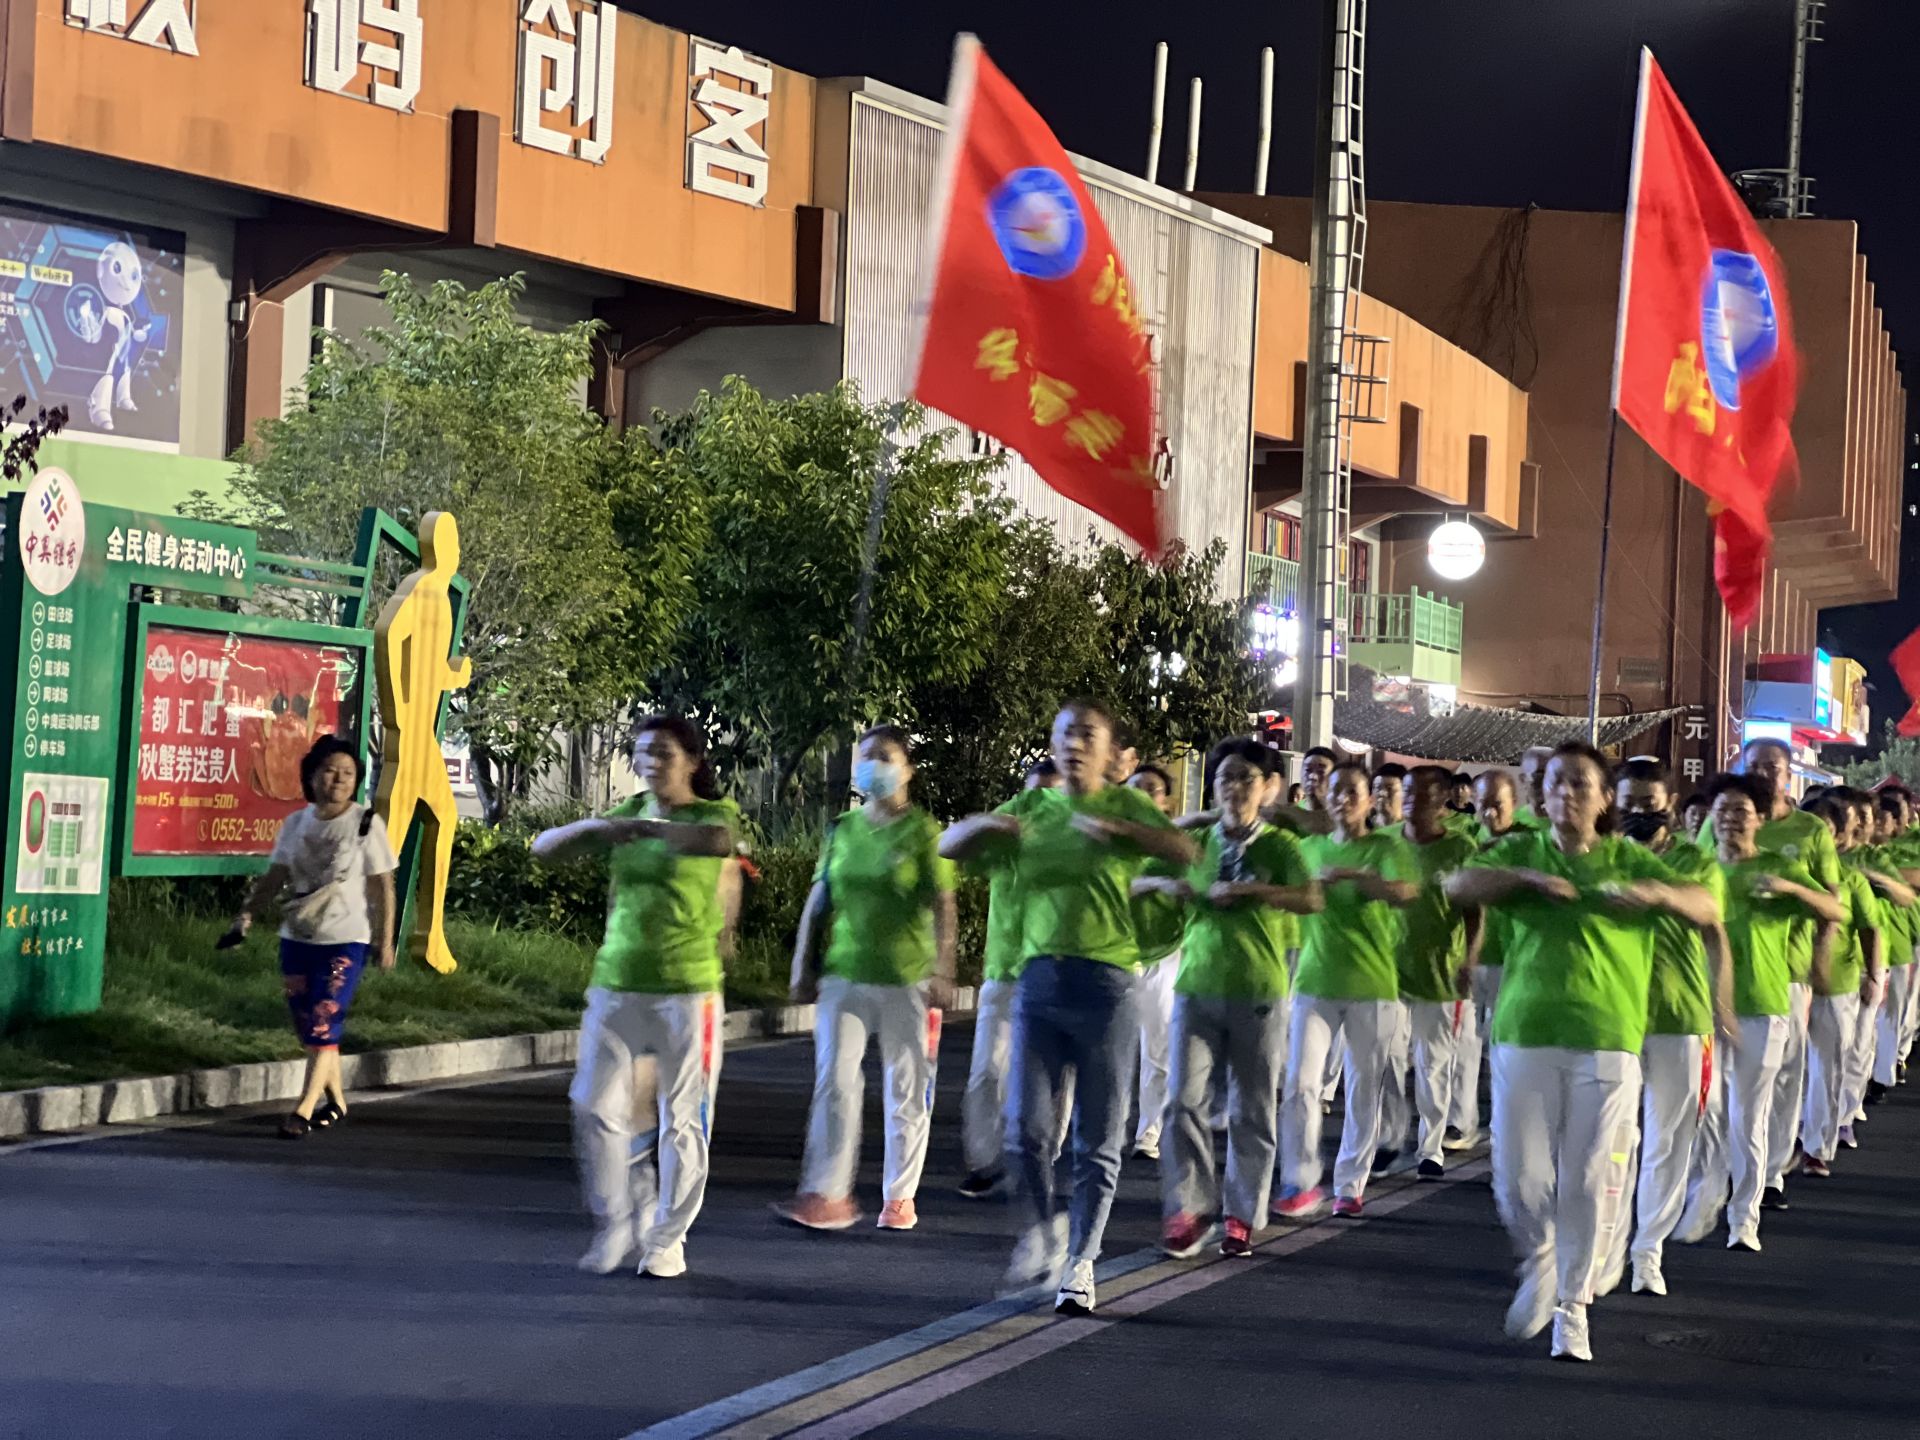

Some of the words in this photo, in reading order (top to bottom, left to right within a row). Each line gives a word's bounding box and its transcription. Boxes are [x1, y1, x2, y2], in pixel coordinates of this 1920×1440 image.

[33, 267, 71, 284] Web开发
[106, 526, 247, 579] 全民健身活动中心
[48, 606, 74, 624] 田径场
[46, 632, 72, 650] 足球场
[44, 660, 70, 677] 篮球场
[141, 695, 241, 737] 都汇肥蟹
[40, 740, 66, 757] 停车场
[138, 744, 240, 784] 秋蟹券送贵人
